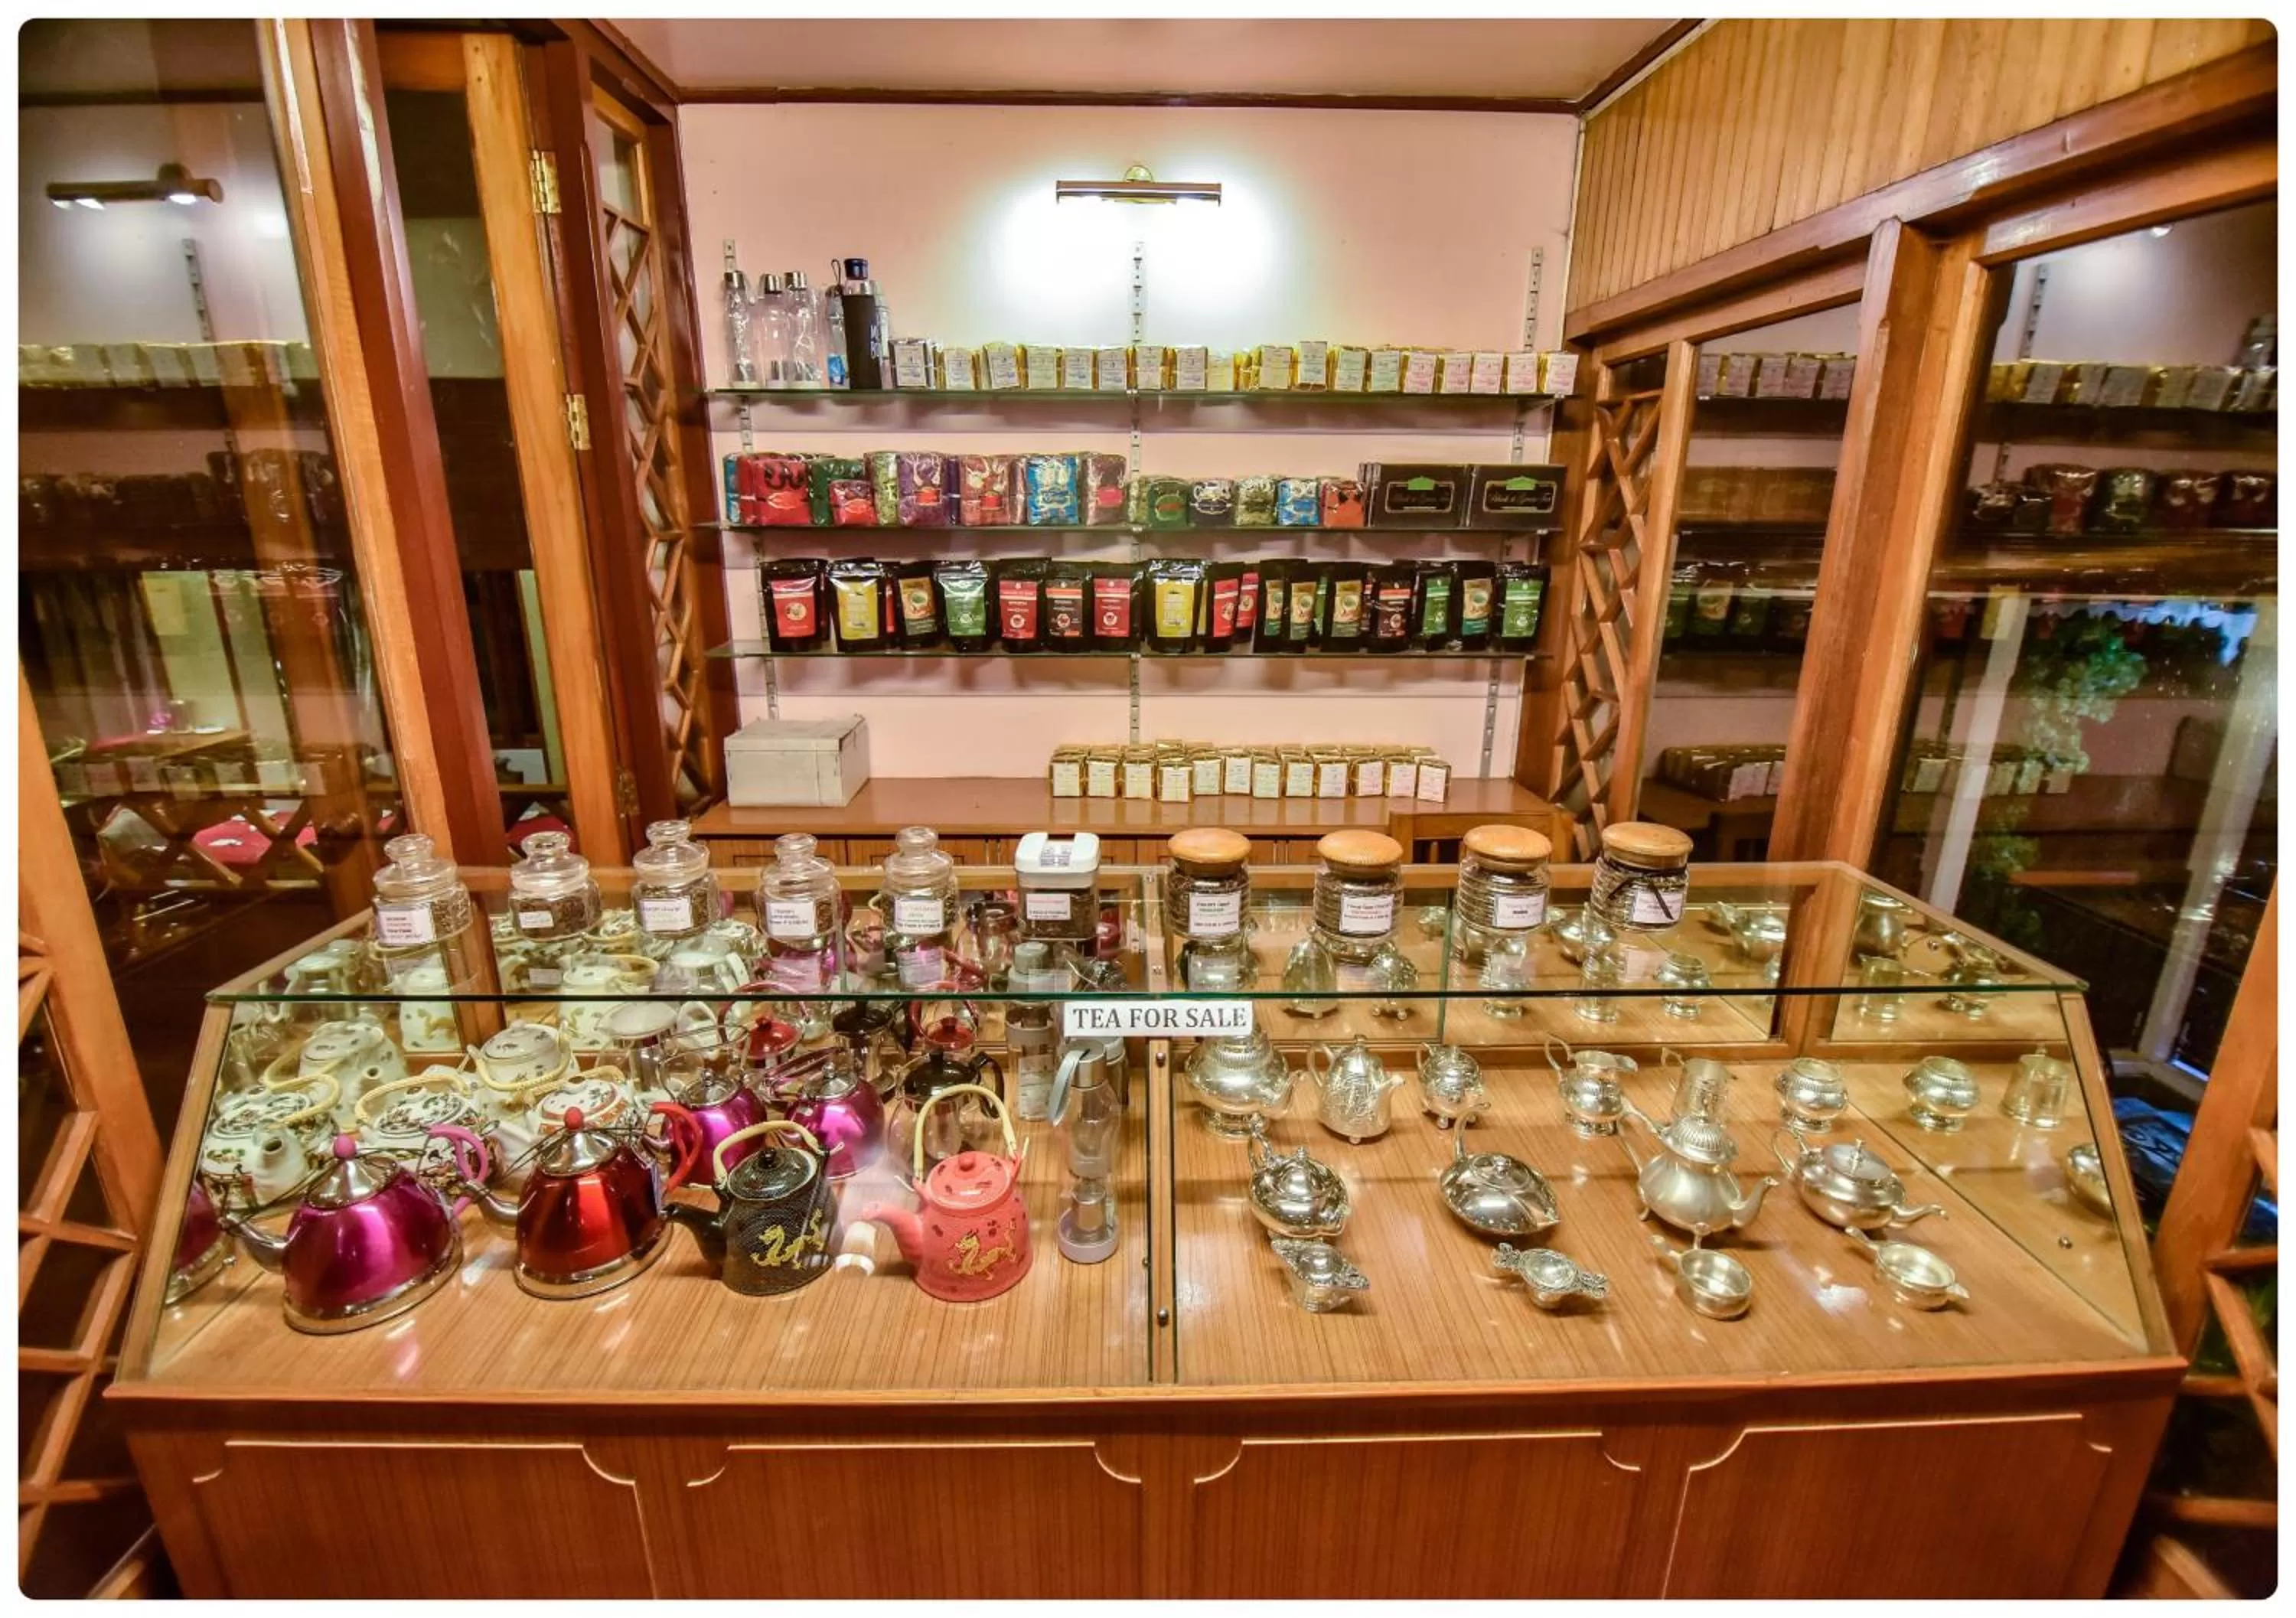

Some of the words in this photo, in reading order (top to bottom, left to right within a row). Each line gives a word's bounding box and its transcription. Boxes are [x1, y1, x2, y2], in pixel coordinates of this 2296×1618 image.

[1072, 1008, 1122, 1029] TEA
[1129, 1008, 1179, 1028] FOR
[1186, 1007, 1247, 1028] SALE
